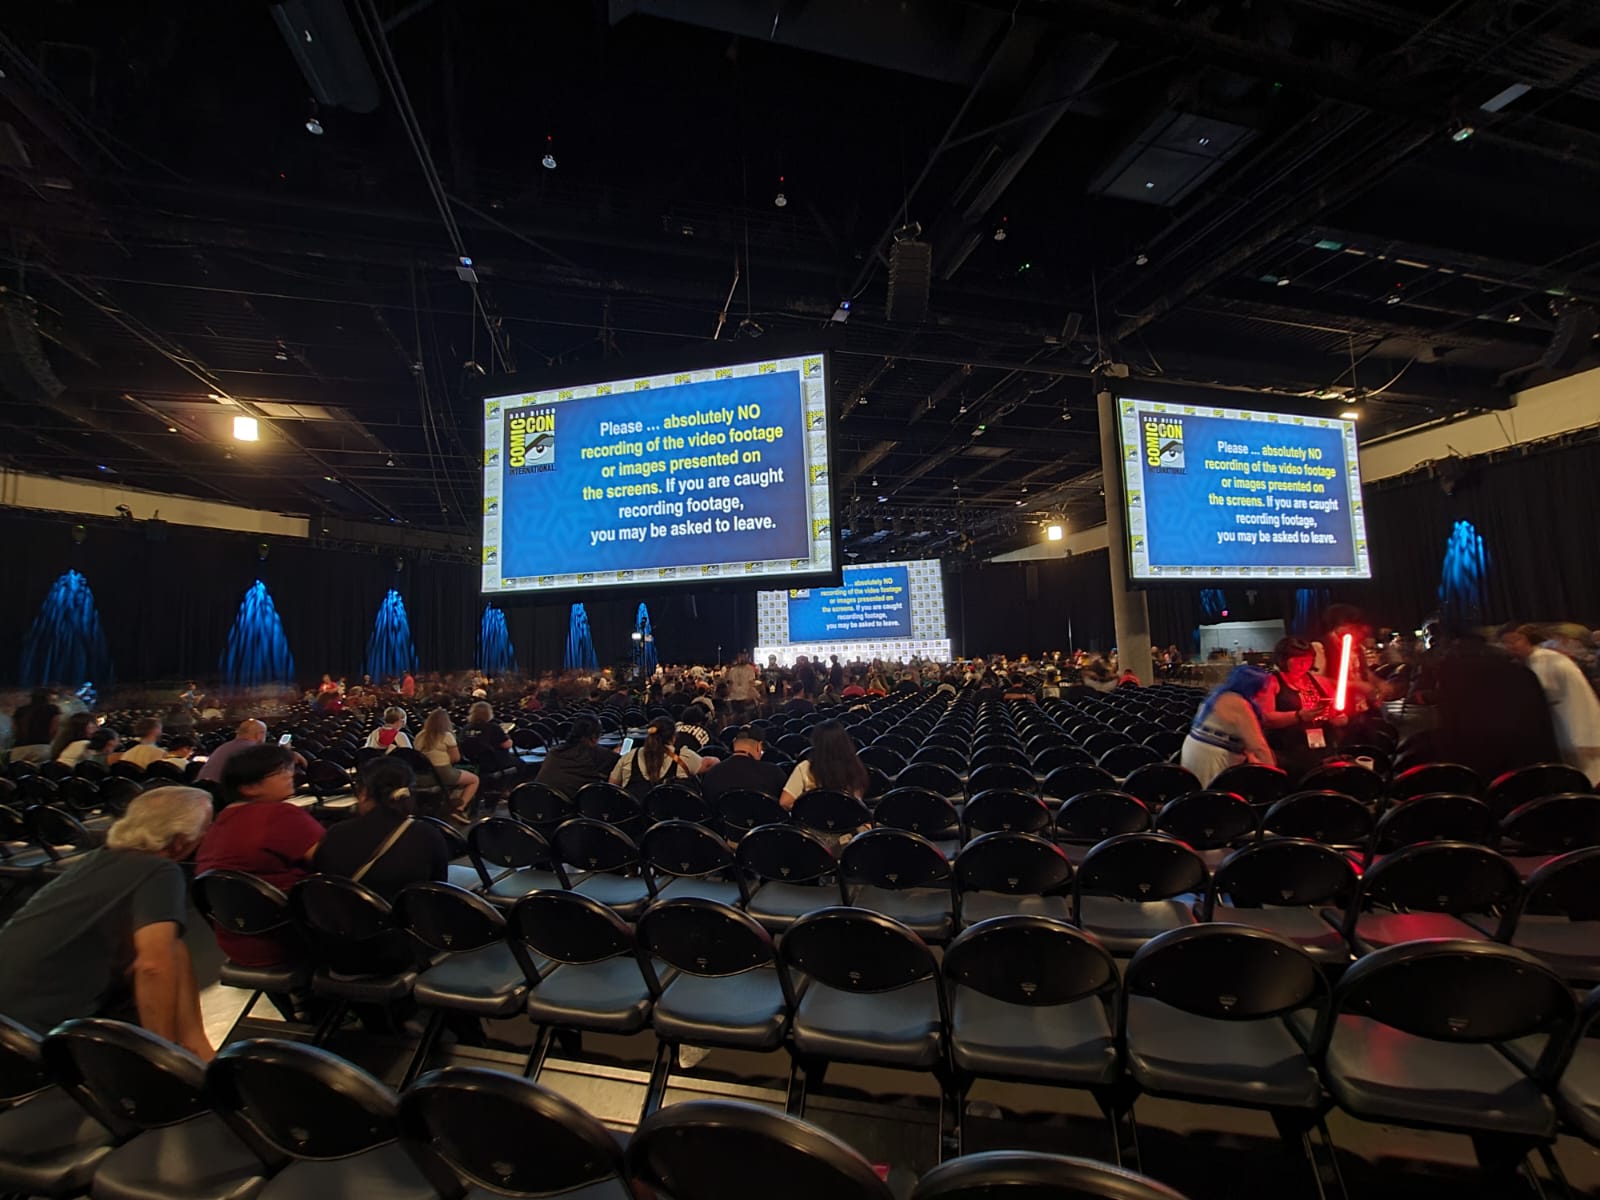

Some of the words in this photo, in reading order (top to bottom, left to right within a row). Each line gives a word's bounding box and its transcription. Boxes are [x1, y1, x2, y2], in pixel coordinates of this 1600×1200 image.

[526, 414, 555, 433] CON
[600, 421, 643, 437] Please
[664, 409, 734, 429] absolutely
[737, 404, 761, 420] NO
[1159, 422, 1183, 440] CON
[510, 418, 526, 467] COMIC
[581, 441, 643, 459] recording
[646, 438, 660, 452] of
[662, 435, 684, 450] the
[688, 431, 726, 447] video
[728, 426, 784, 443] footage
[1145, 422, 1161, 467] COMIC
[1217, 441, 1249, 454] Please
[1262, 445, 1306, 461] absolutely
[1308, 448, 1322, 460] NO
[601, 465, 616, 478] or
[619, 460, 666, 477] images
[669, 451, 739, 474] presented
[742, 450, 761, 463] on
[1204, 459, 1250, 474] recording
[1251, 460, 1261, 472] of
[1262, 461, 1277, 473] the
[1279, 463, 1303, 475] video
[1303, 464, 1336, 480] footage
[582, 486, 603, 501] the
[606, 483, 663, 498] screens.
[665, 478, 677, 493] If
[677, 477, 704, 495] you
[708, 476, 730, 489] are
[734, 467, 784, 488] caught
[1221, 477, 1232, 488] or
[1233, 476, 1266, 492] images
[1268, 480, 1311, 493] presented
[1313, 483, 1325, 493] on
[618, 500, 683, 518] recording
[686, 497, 744, 512] footage,
[1208, 493, 1224, 505] the
[1226, 496, 1265, 507] screens.
[1266, 495, 1273, 507] If
[1274, 499, 1292, 510] you
[1293, 499, 1307, 509] are
[1309, 498, 1339, 513] caught
[590, 529, 616, 546] you
[619, 525, 647, 543] may
[651, 523, 667, 538] be
[671, 519, 712, 536] asked
[715, 518, 730, 533] to
[733, 515, 776, 532] leave.
[1236, 513, 1280, 528] recording
[1281, 513, 1318, 529] footage,
[1217, 531, 1236, 544] you
[1237, 532, 1257, 544] may
[1259, 530, 1270, 542] be
[1272, 531, 1299, 543] asked
[1300, 532, 1310, 543] to
[1311, 531, 1337, 544] leave.
[857, 595, 885, 603] presented
[861, 604, 872, 612] you
[837, 613, 864, 621] recording
[837, 622, 849, 630] may
